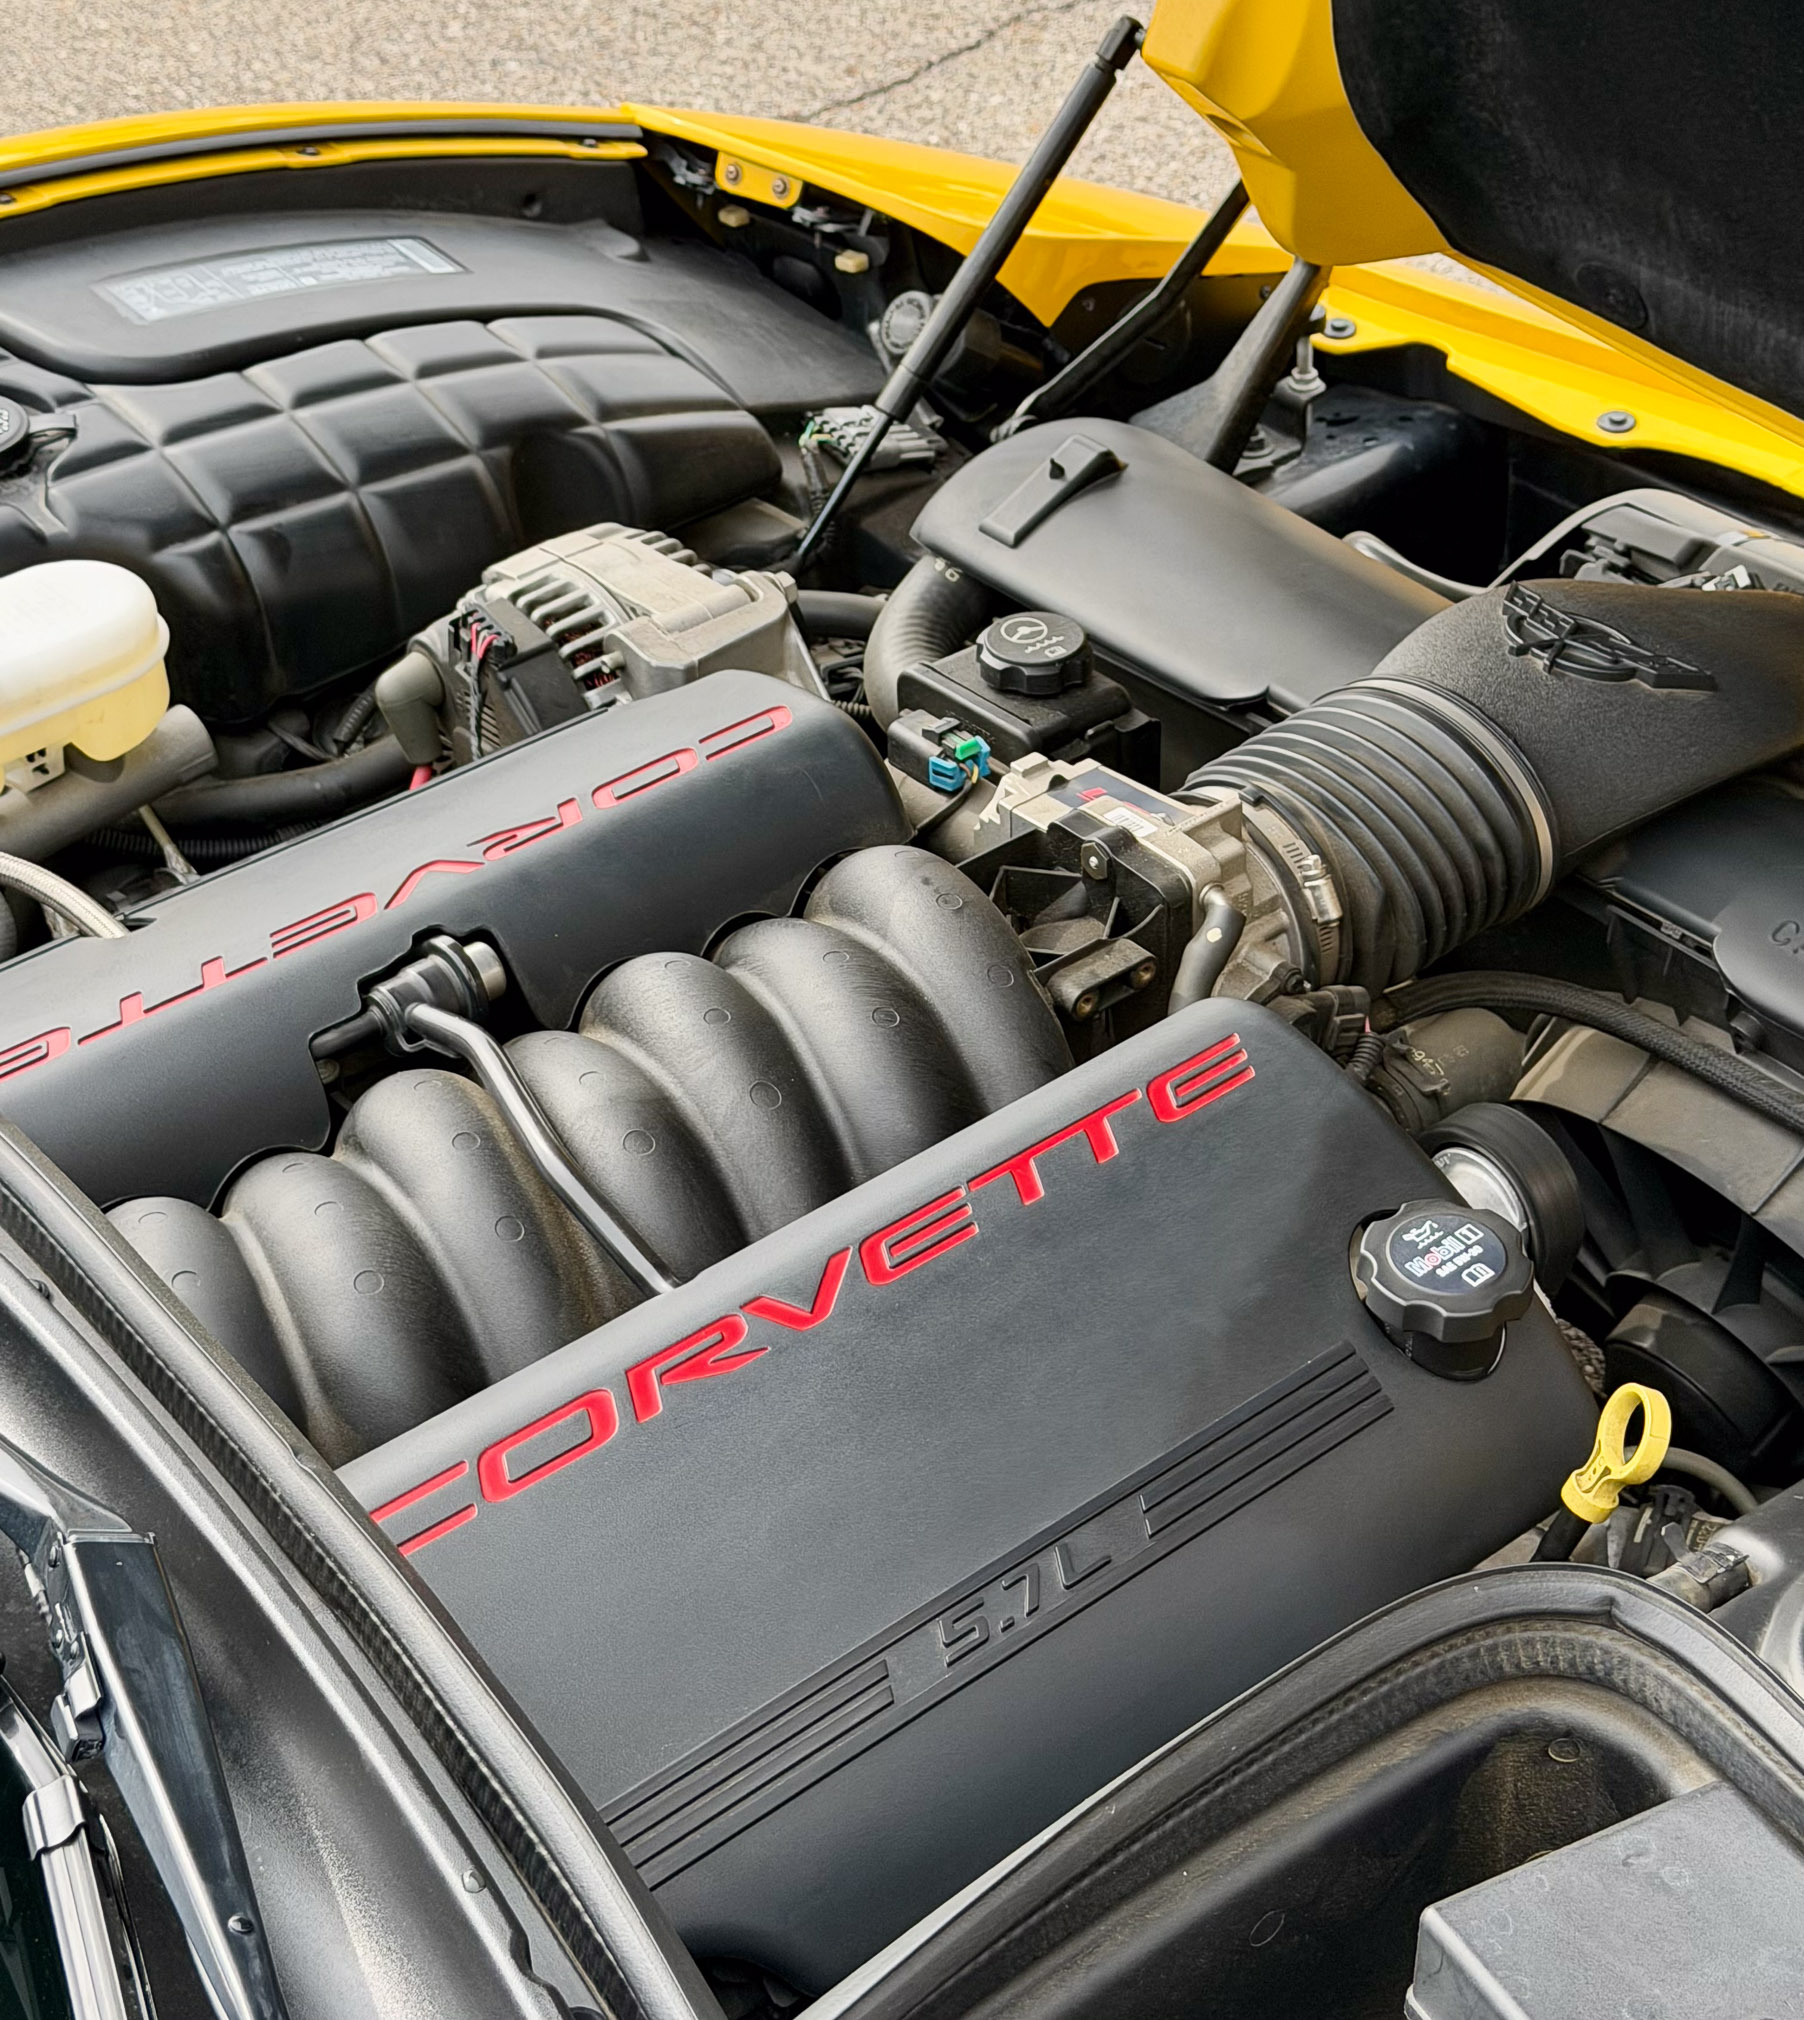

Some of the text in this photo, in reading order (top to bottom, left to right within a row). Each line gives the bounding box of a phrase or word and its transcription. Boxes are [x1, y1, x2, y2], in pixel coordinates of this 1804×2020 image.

[1404, 1224, 1482, 1277] Mobil 1
[937, 1543, 1112, 1668] 5.7L
